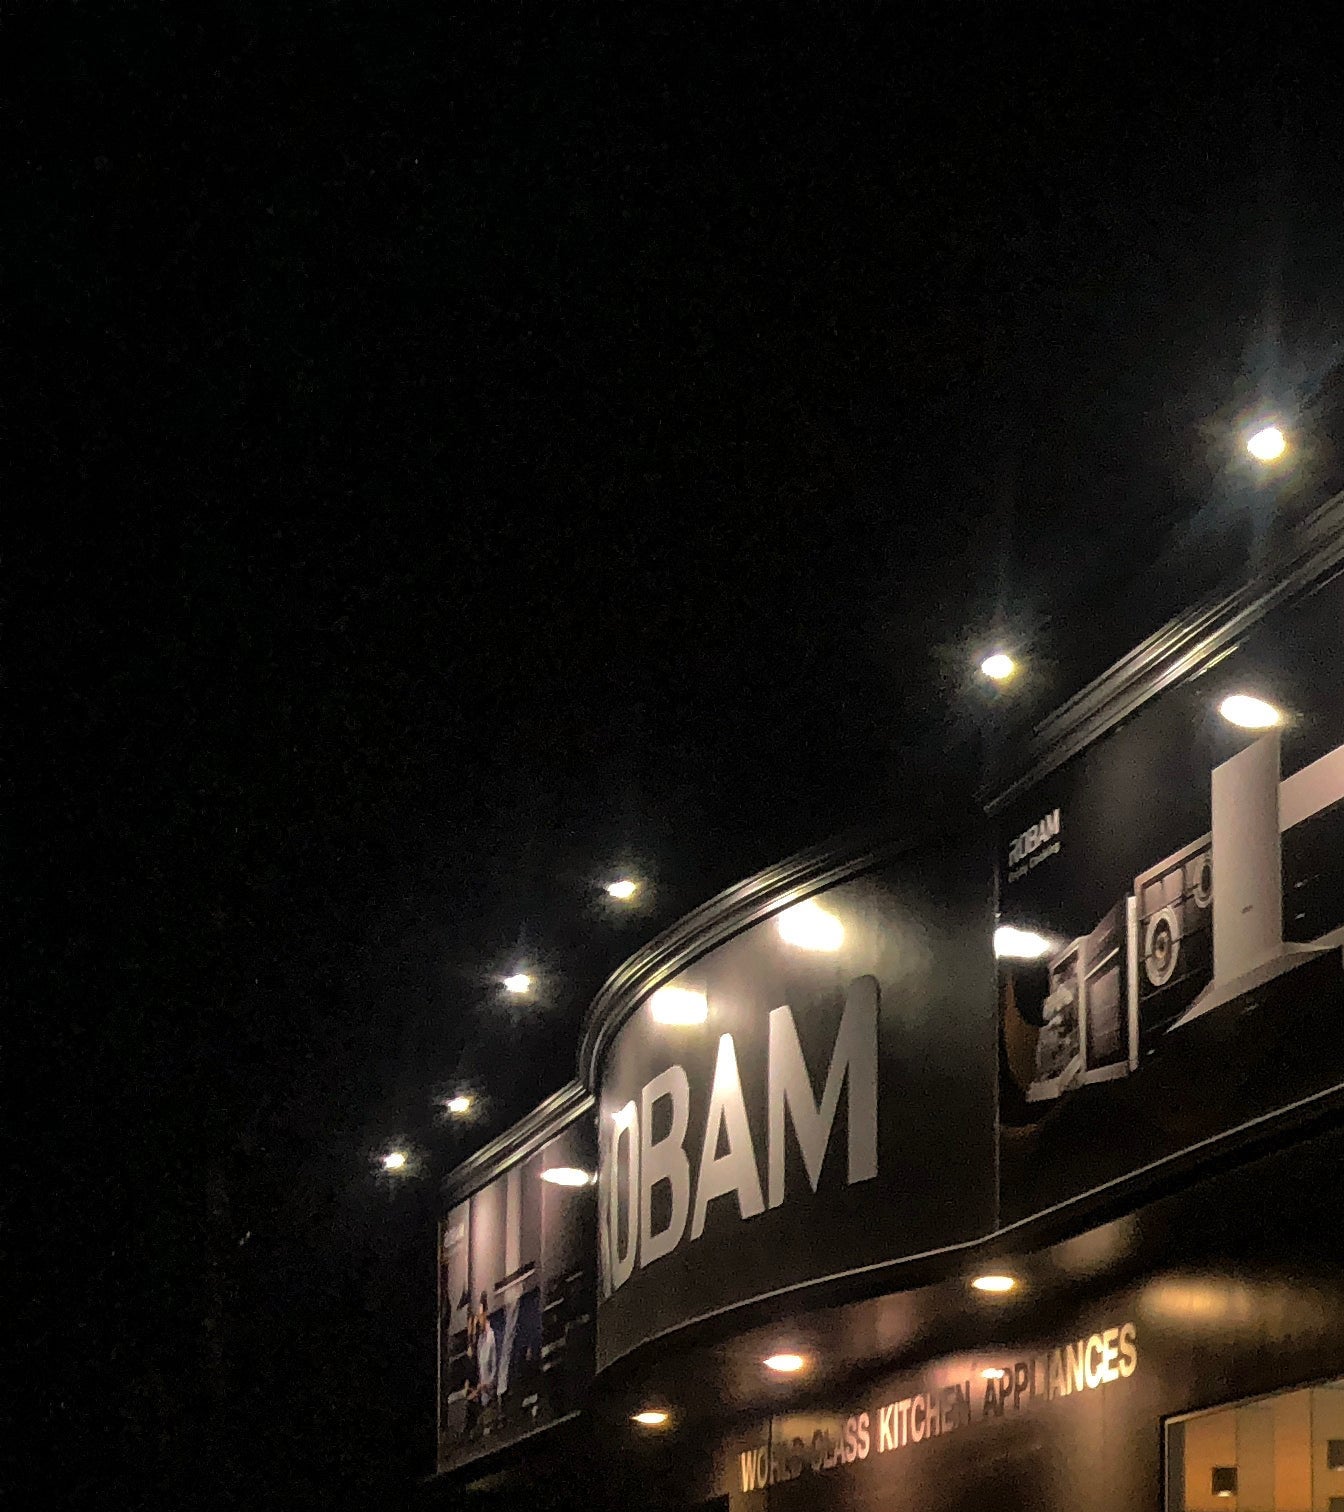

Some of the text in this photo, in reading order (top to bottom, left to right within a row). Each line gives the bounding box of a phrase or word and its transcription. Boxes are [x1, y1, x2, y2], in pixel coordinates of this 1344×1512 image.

[1009, 808, 1061, 867] ROBAM
[600, 975, 881, 1299] OBAM
[877, 1380, 971, 1453] KITCHEN
[983, 1322, 1138, 1416] APPLIANCES
